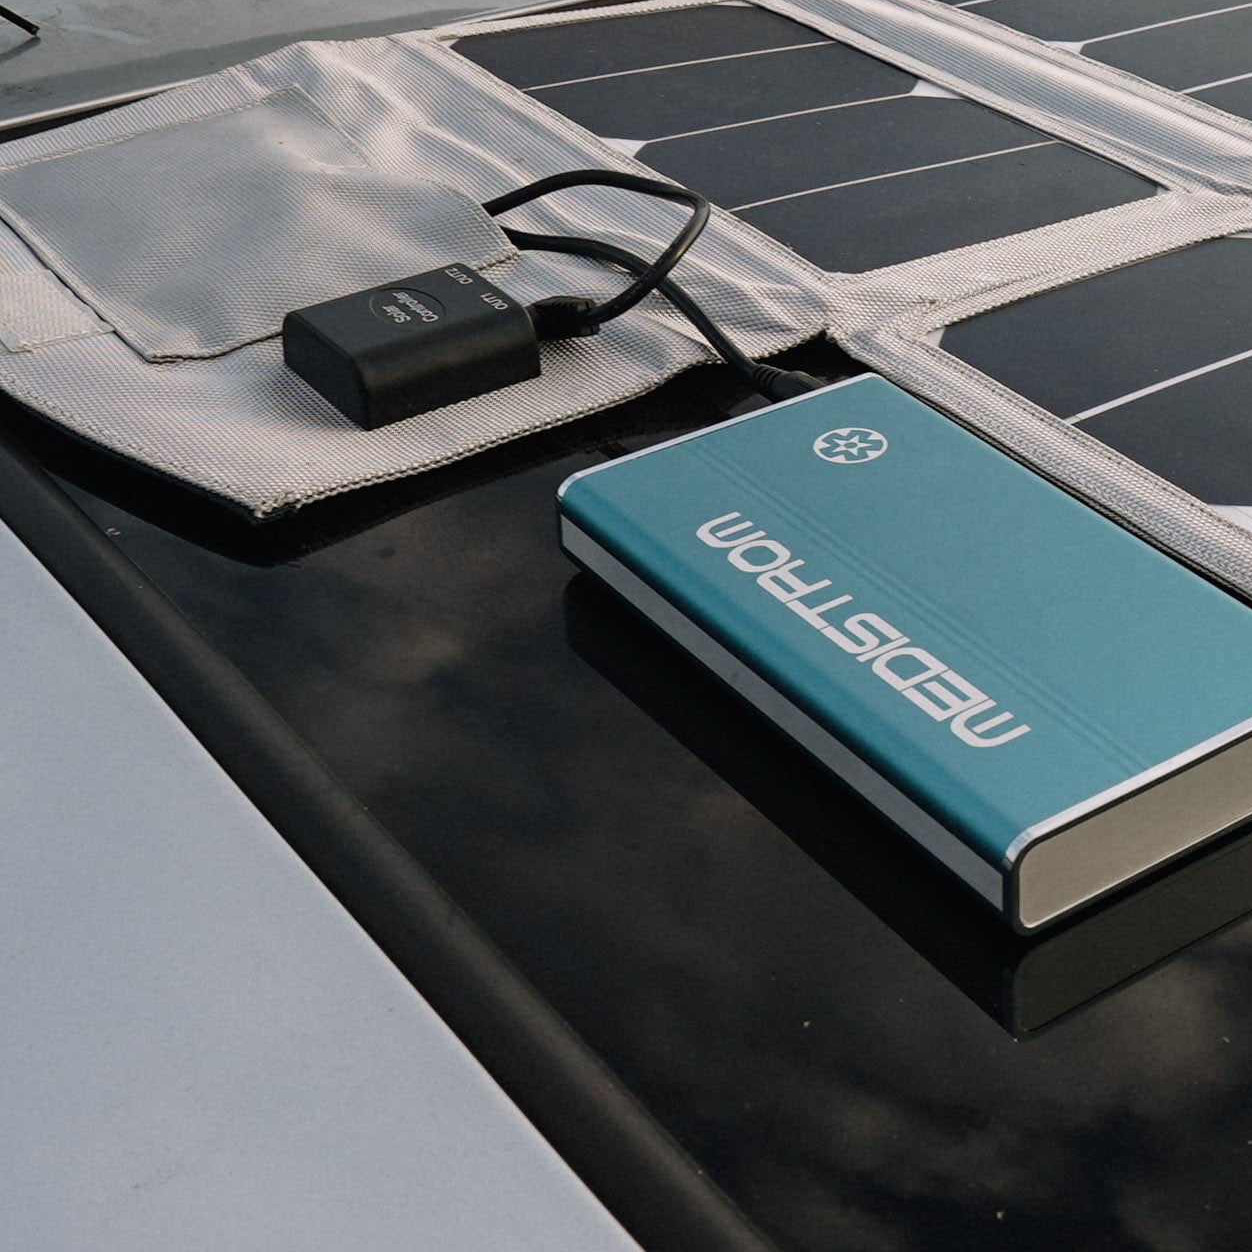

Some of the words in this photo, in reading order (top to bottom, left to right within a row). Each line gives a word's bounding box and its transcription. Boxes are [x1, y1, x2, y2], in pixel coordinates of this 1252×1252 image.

[382, 305, 411, 323] Solar
[392, 291, 439, 322] Controller
[695, 511, 1031, 748] MEDISTROM
